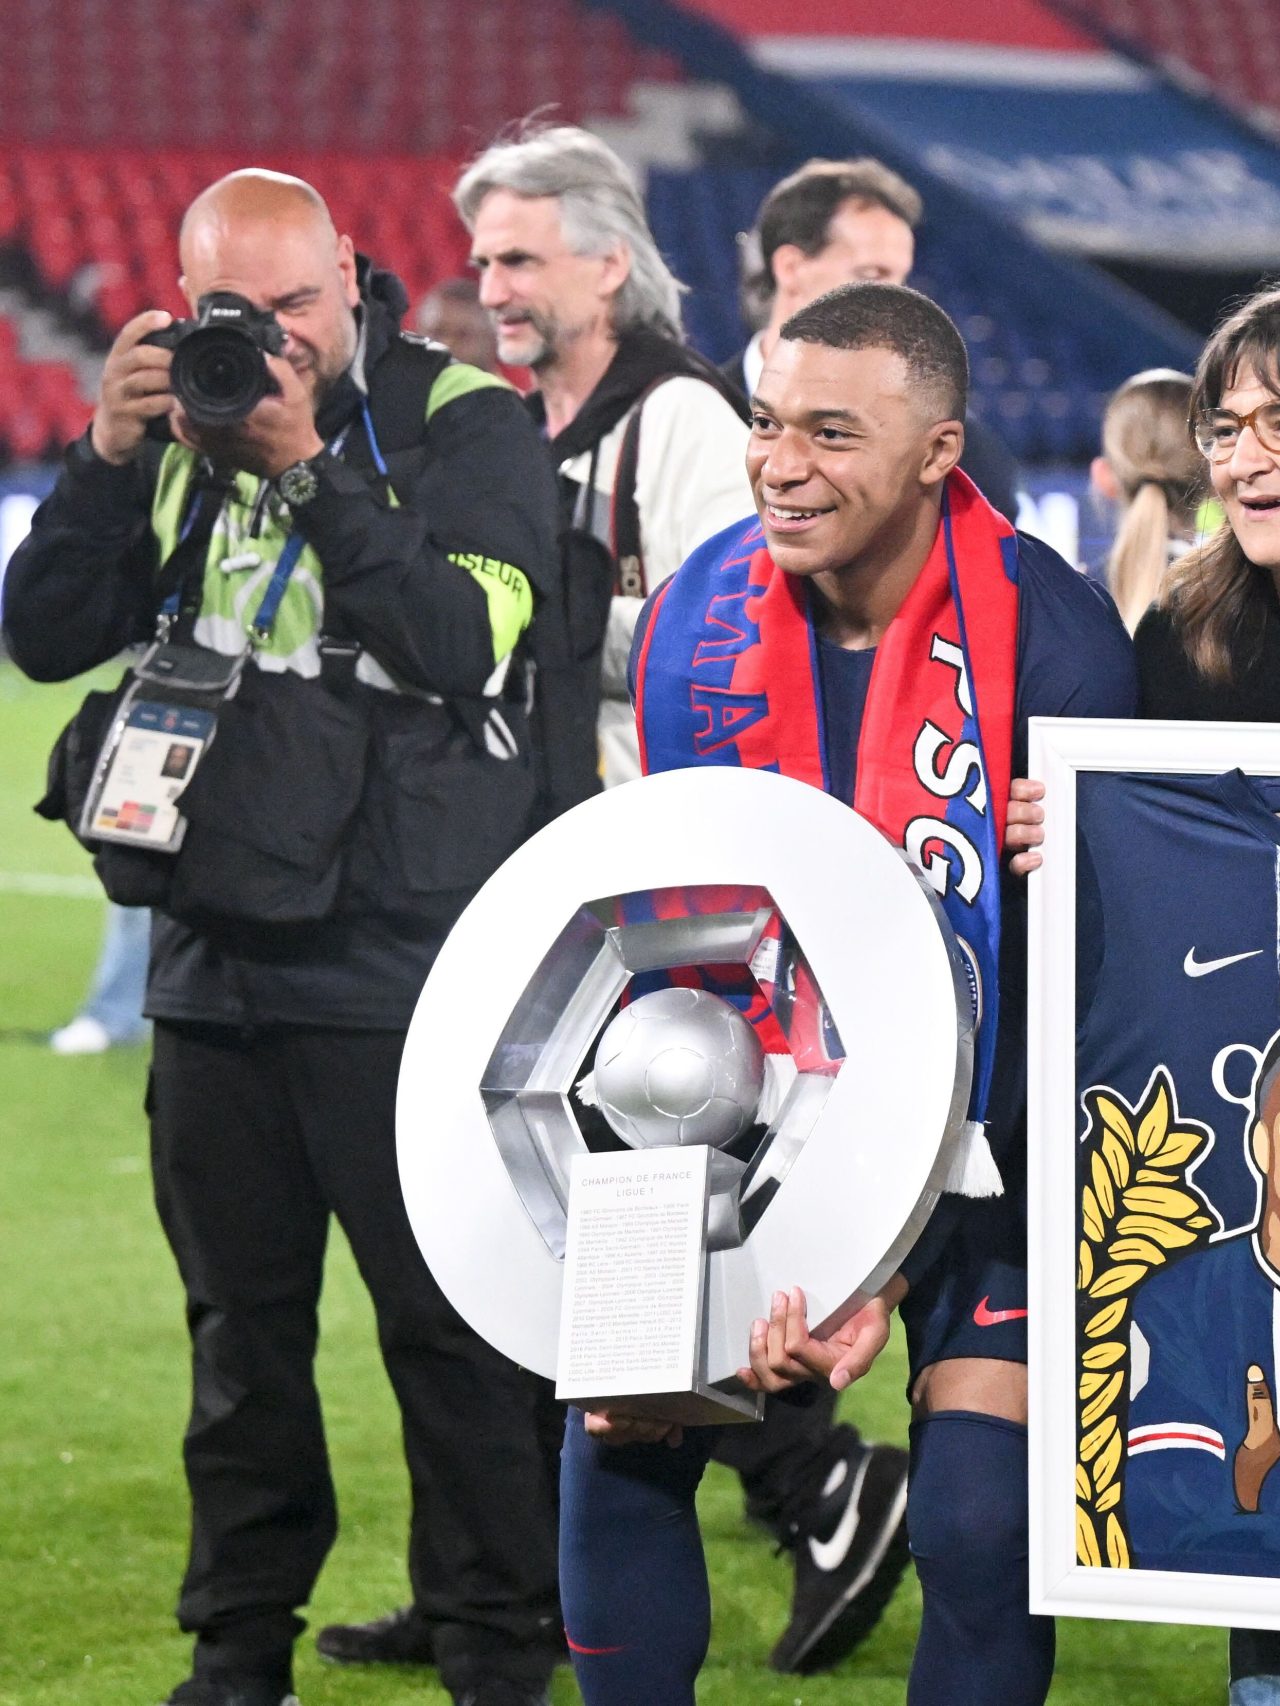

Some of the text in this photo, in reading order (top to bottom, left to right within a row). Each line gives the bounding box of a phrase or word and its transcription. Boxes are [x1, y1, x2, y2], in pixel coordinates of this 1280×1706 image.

[454, 553, 523, 601] SEUR
[581, 1170, 692, 1187] CHAMPION DE FRANCE
[616, 1187, 646, 1198] LIGUE
